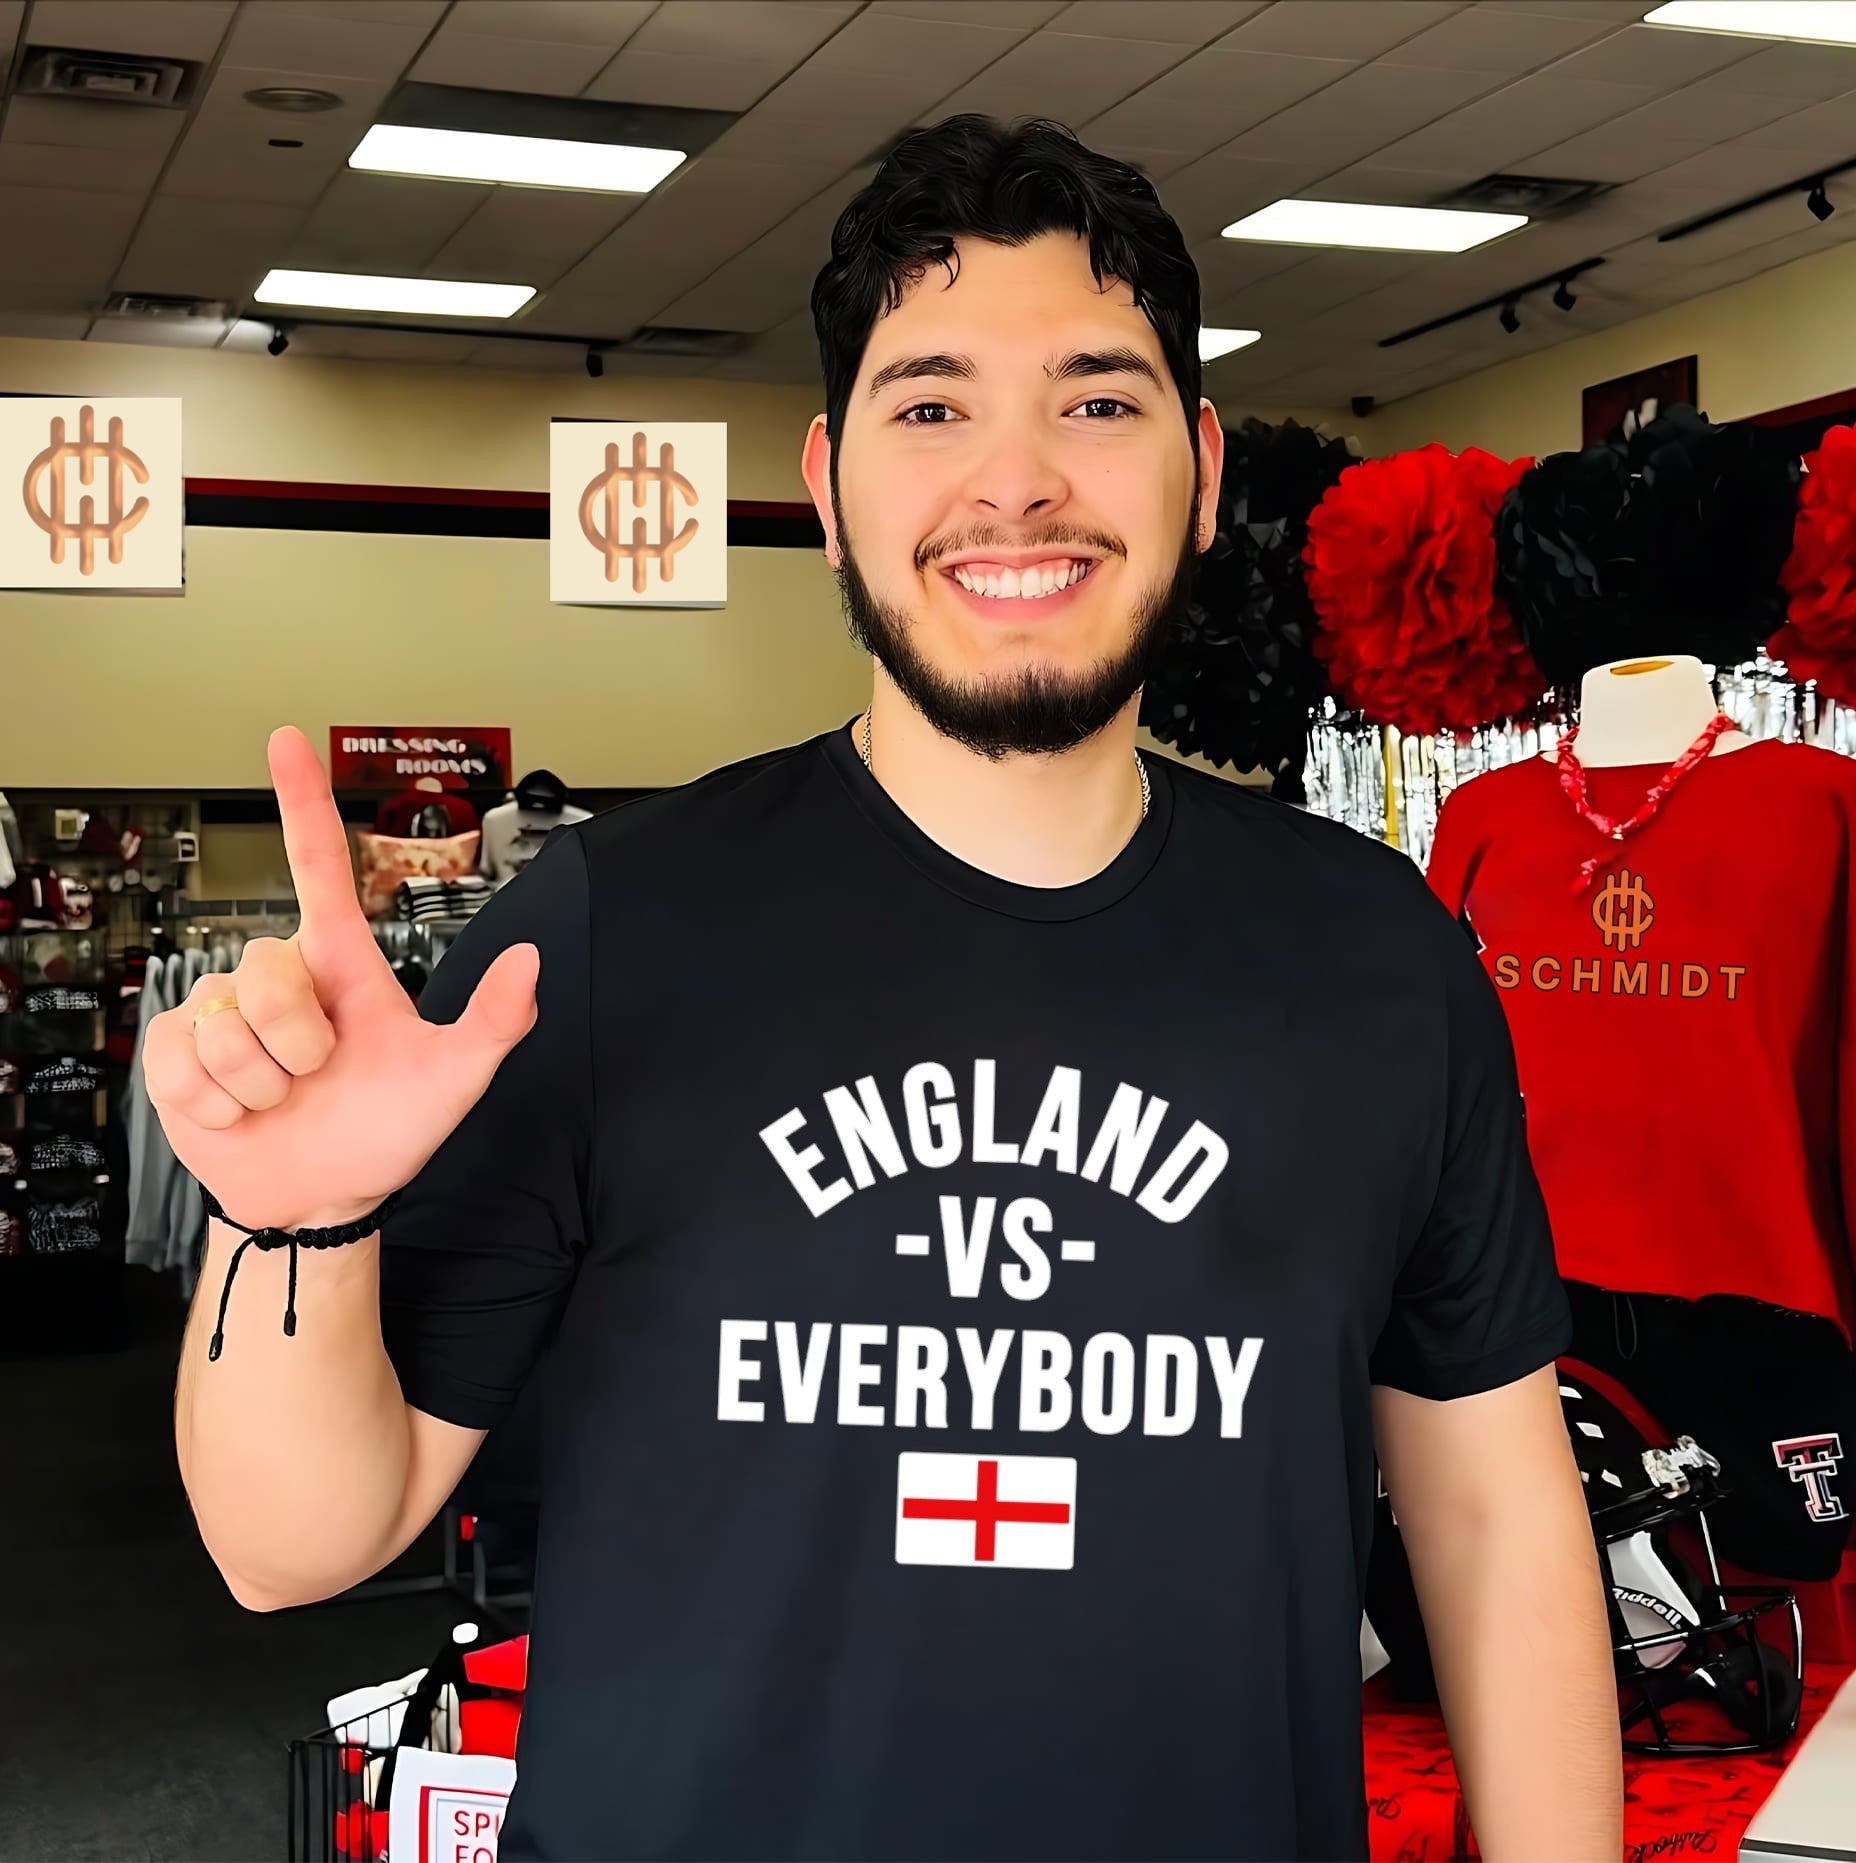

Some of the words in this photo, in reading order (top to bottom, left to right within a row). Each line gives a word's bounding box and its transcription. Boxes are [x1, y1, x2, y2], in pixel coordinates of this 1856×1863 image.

[342, 737, 467, 754] DRESSING
[396, 758, 487, 775] ROOMS
[1493, 954, 1747, 1001] SCHMIDT
[758, 1058, 1230, 1224] ENGLAND
[716, 1318, 1265, 1440] EVERYBODY
